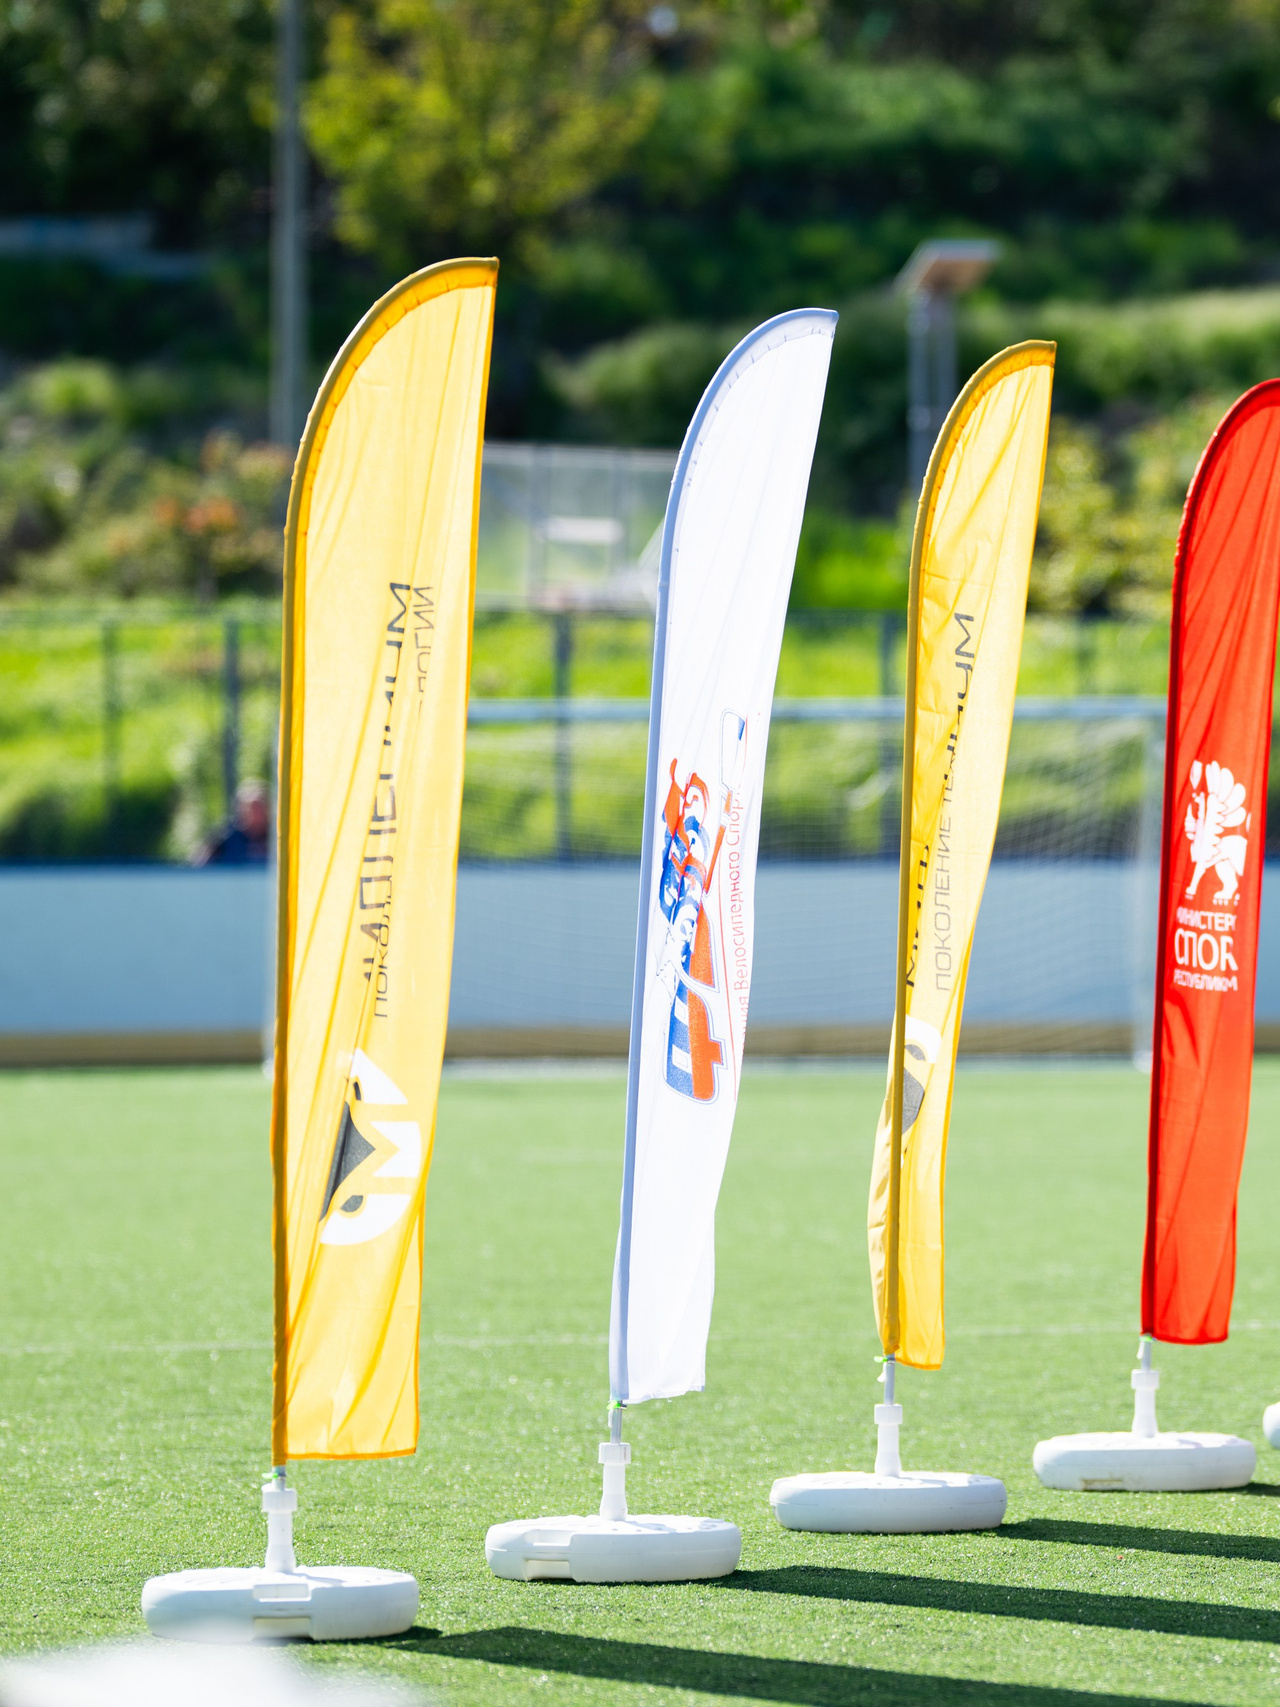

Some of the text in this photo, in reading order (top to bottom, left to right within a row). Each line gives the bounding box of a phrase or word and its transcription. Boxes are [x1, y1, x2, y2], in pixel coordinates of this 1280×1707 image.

[726, 792, 744, 846] Спор
[728, 851, 749, 991] Велосипедного
[934, 816, 952, 992] ПОКОЛЕНИЕ
